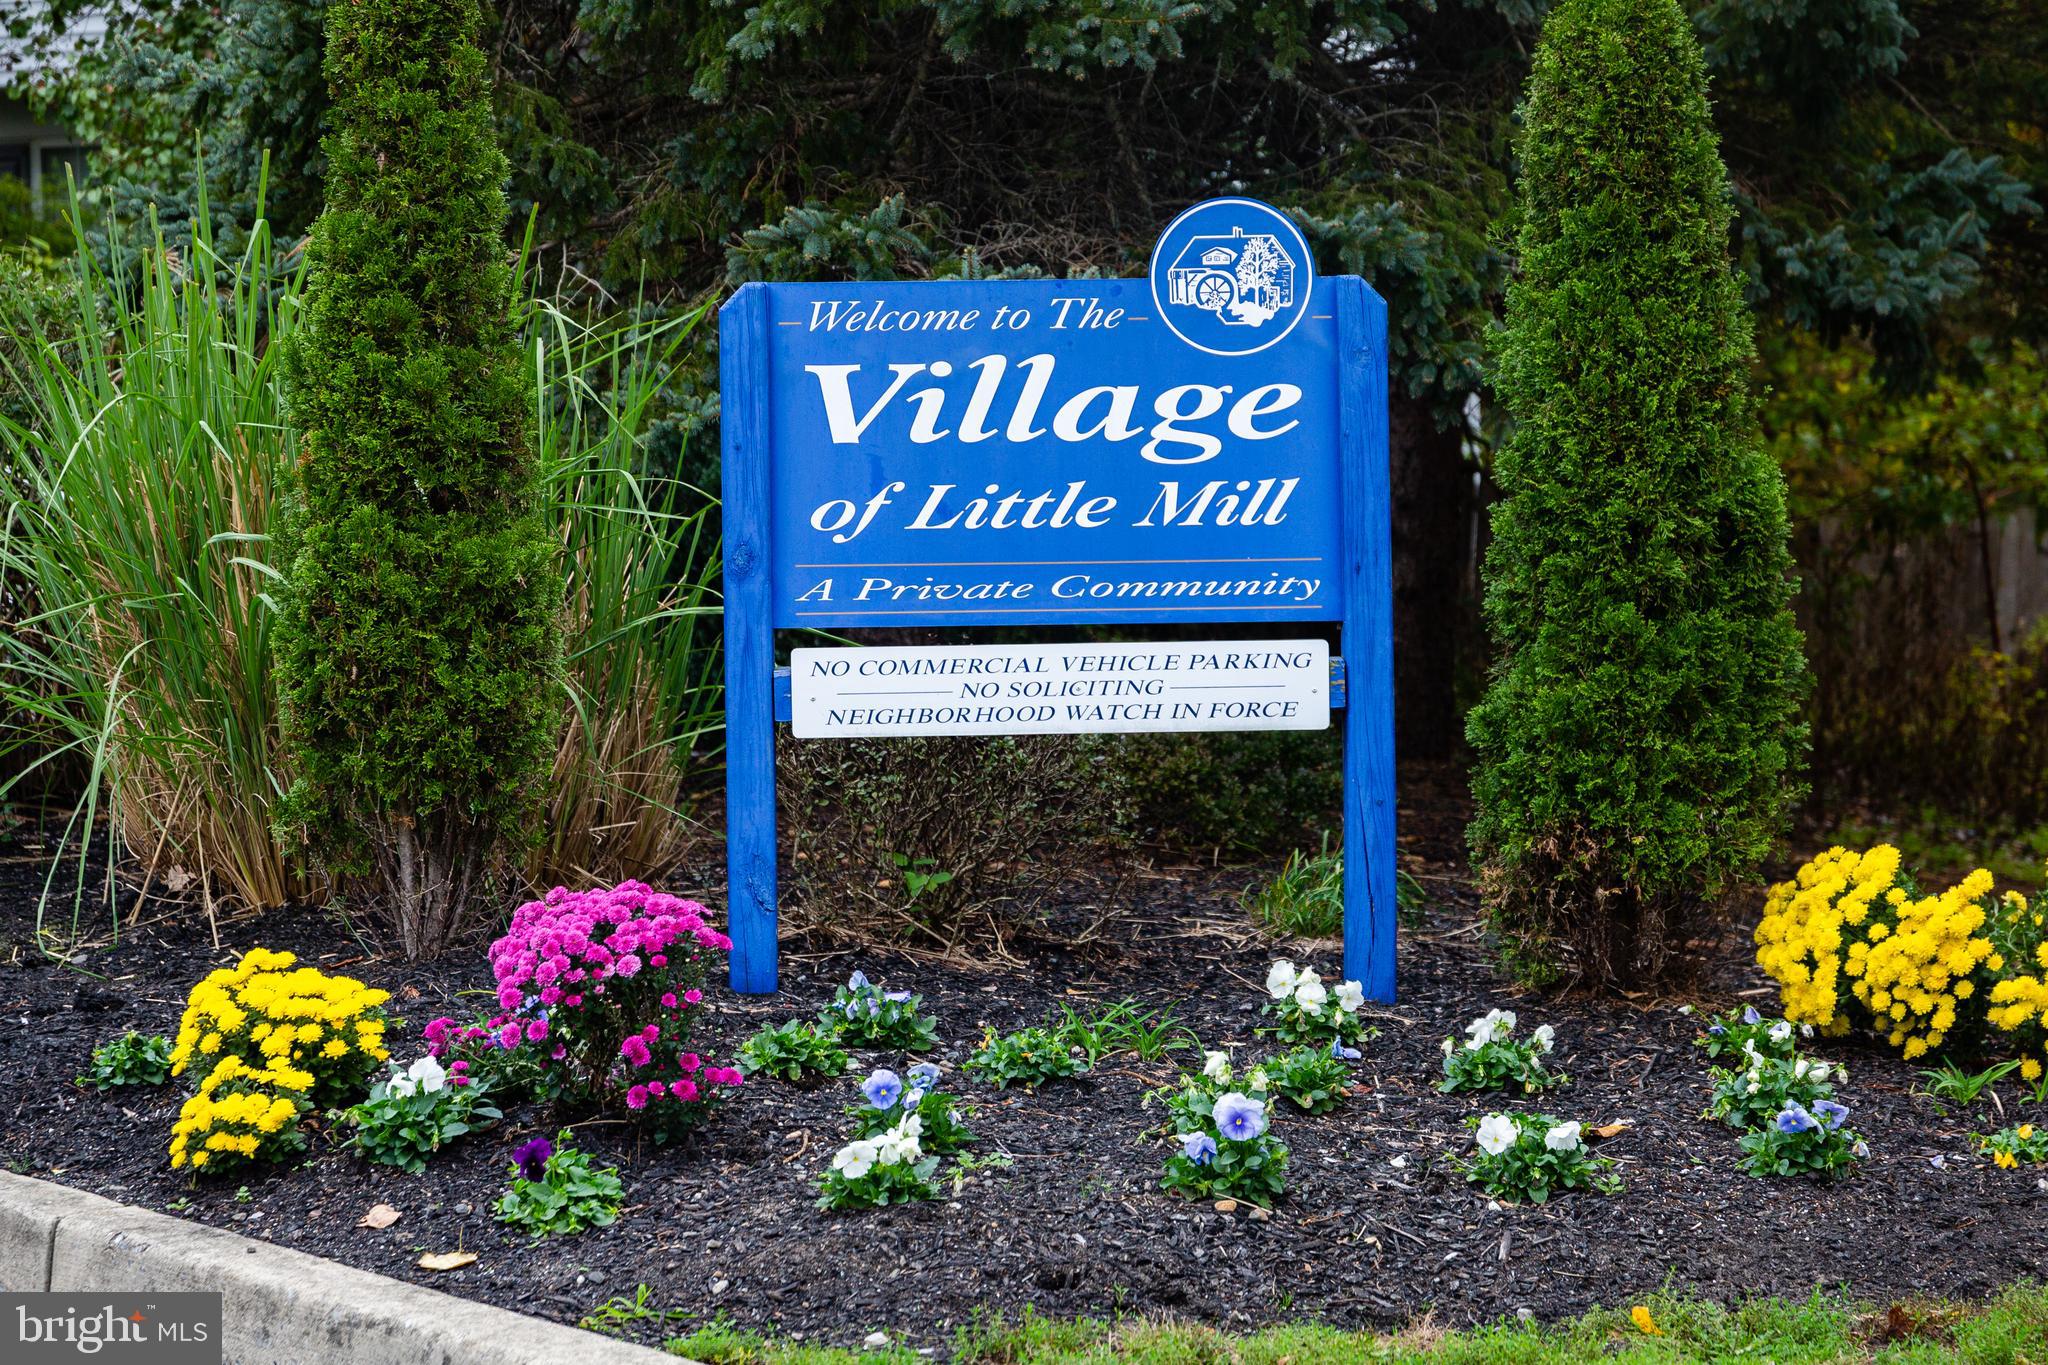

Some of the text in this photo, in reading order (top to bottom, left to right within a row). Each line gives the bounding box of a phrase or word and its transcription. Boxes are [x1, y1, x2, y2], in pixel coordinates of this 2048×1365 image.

[808, 297, 1126, 333] Welcome to The
[804, 353, 1303, 465] Village
[809, 476, 1301, 544] of Little Mill
[795, 571, 1322, 602] A Private Community
[810, 651, 1313, 678] NO COMMERCIAL VEHICLE PARKING
[960, 678, 1165, 699] NO SOLICITING
[826, 700, 1299, 727] NEIGHBORHOOD WATCH IN FORCE
